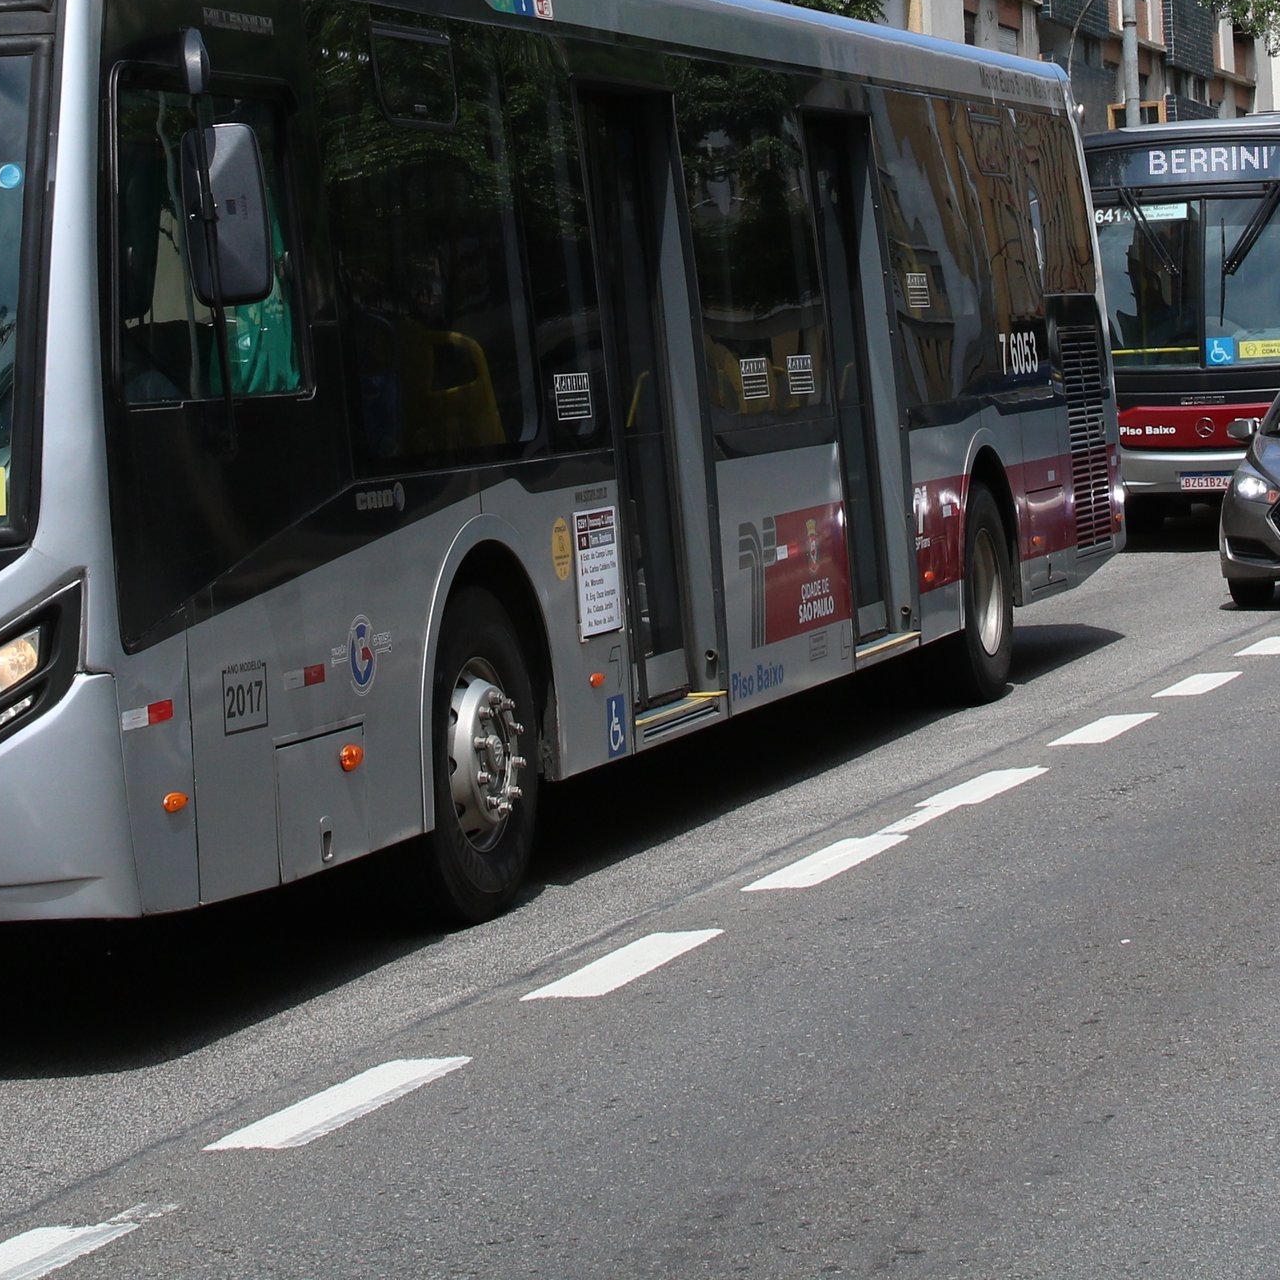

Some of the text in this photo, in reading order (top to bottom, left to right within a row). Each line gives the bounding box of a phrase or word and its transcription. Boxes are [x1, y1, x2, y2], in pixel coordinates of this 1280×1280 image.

[1149, 146, 1269, 175] BERRINI
[999, 331, 1039, 376] 7 6053
[1120, 426, 1176, 436] Piso Baixo
[355, 489, 394, 510] CAIO
[801, 580, 821, 600] CIDADE
[813, 598, 835, 620] PAULO
[227, 660, 263, 674] ANO MODELO
[731, 663, 784, 701] Piso Baixo
[226, 680, 264, 719] 2017
